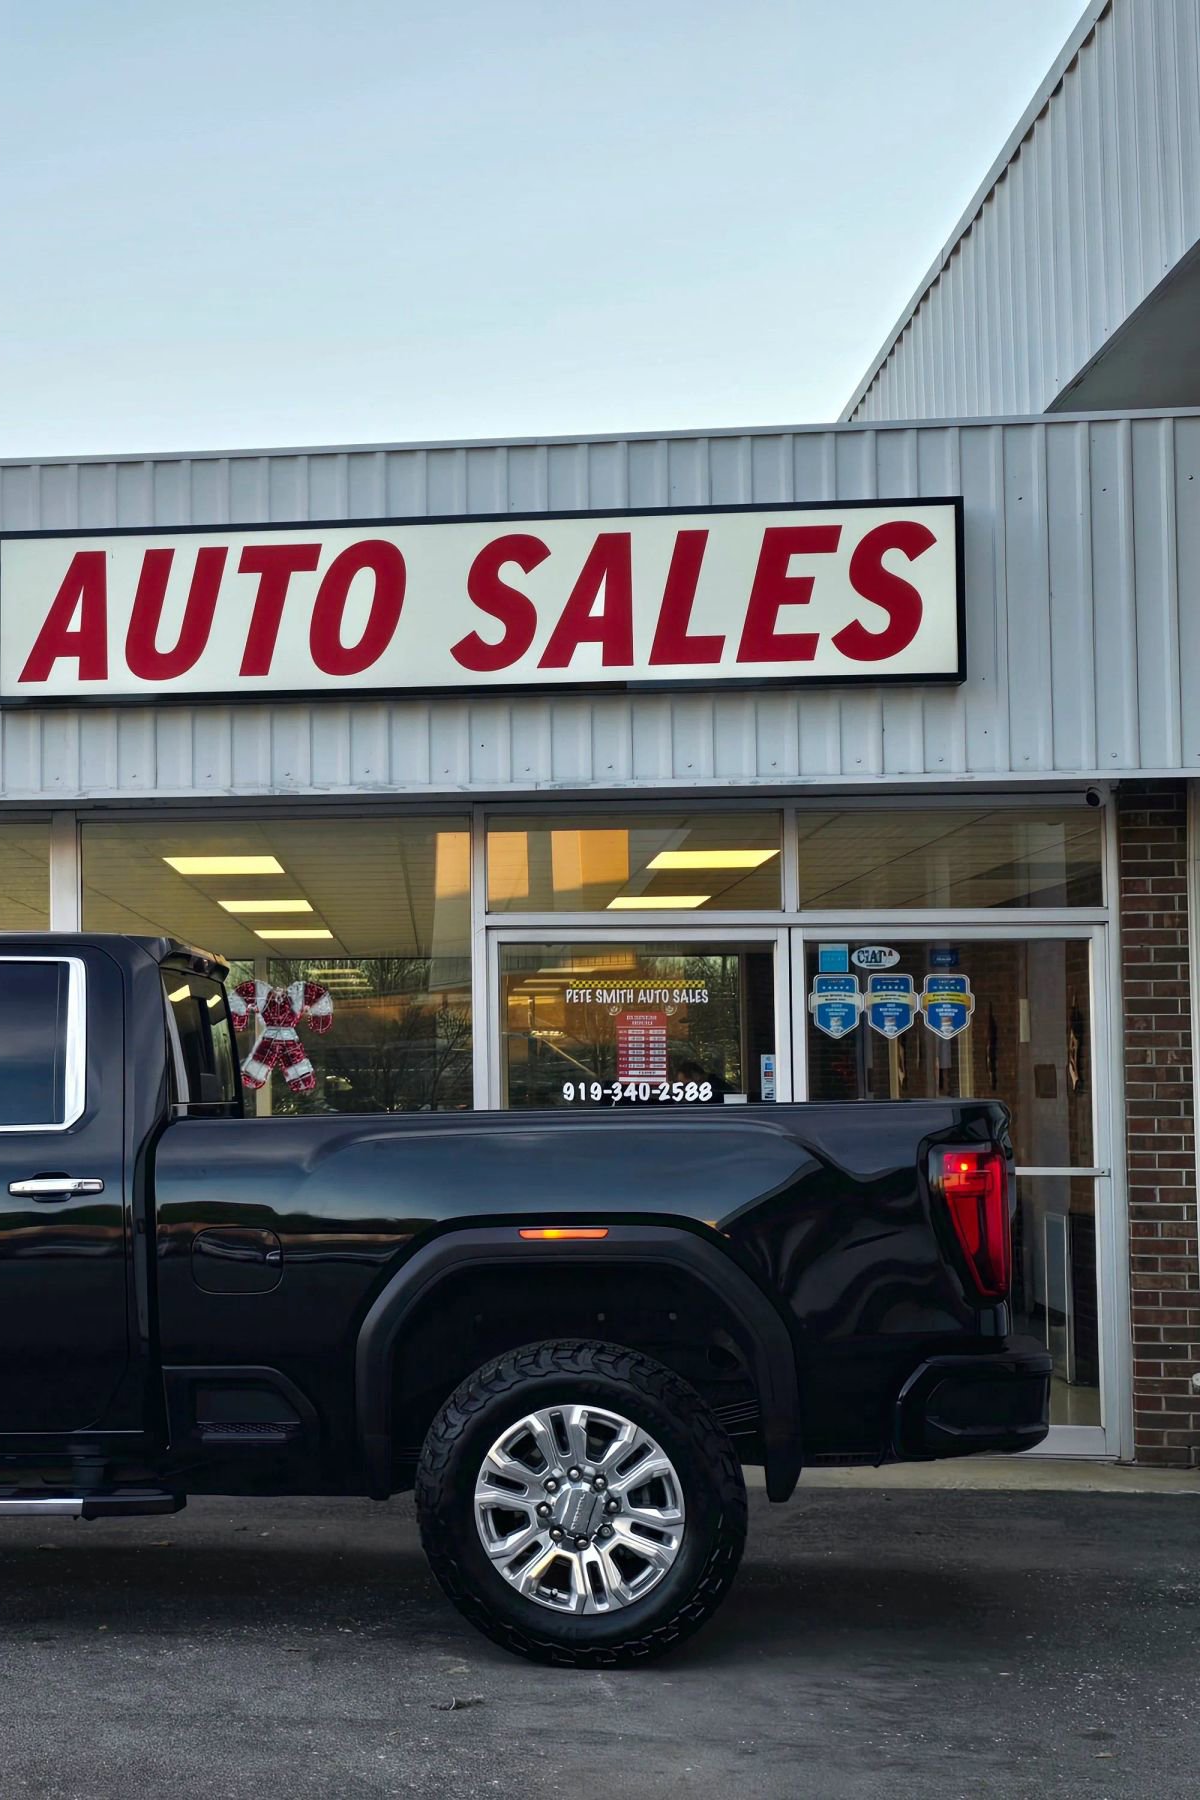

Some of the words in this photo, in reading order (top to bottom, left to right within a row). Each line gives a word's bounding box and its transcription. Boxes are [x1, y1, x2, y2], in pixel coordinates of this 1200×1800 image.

[18, 538, 407, 684] AUTO
[449, 520, 937, 673] SALES
[565, 988, 592, 1004] PETE
[595, 988, 634, 1004] SMITH
[637, 988, 670, 1004] AUTO
[672, 988, 709, 1004] SALES
[562, 1081, 713, 1102] 919-340-2588
